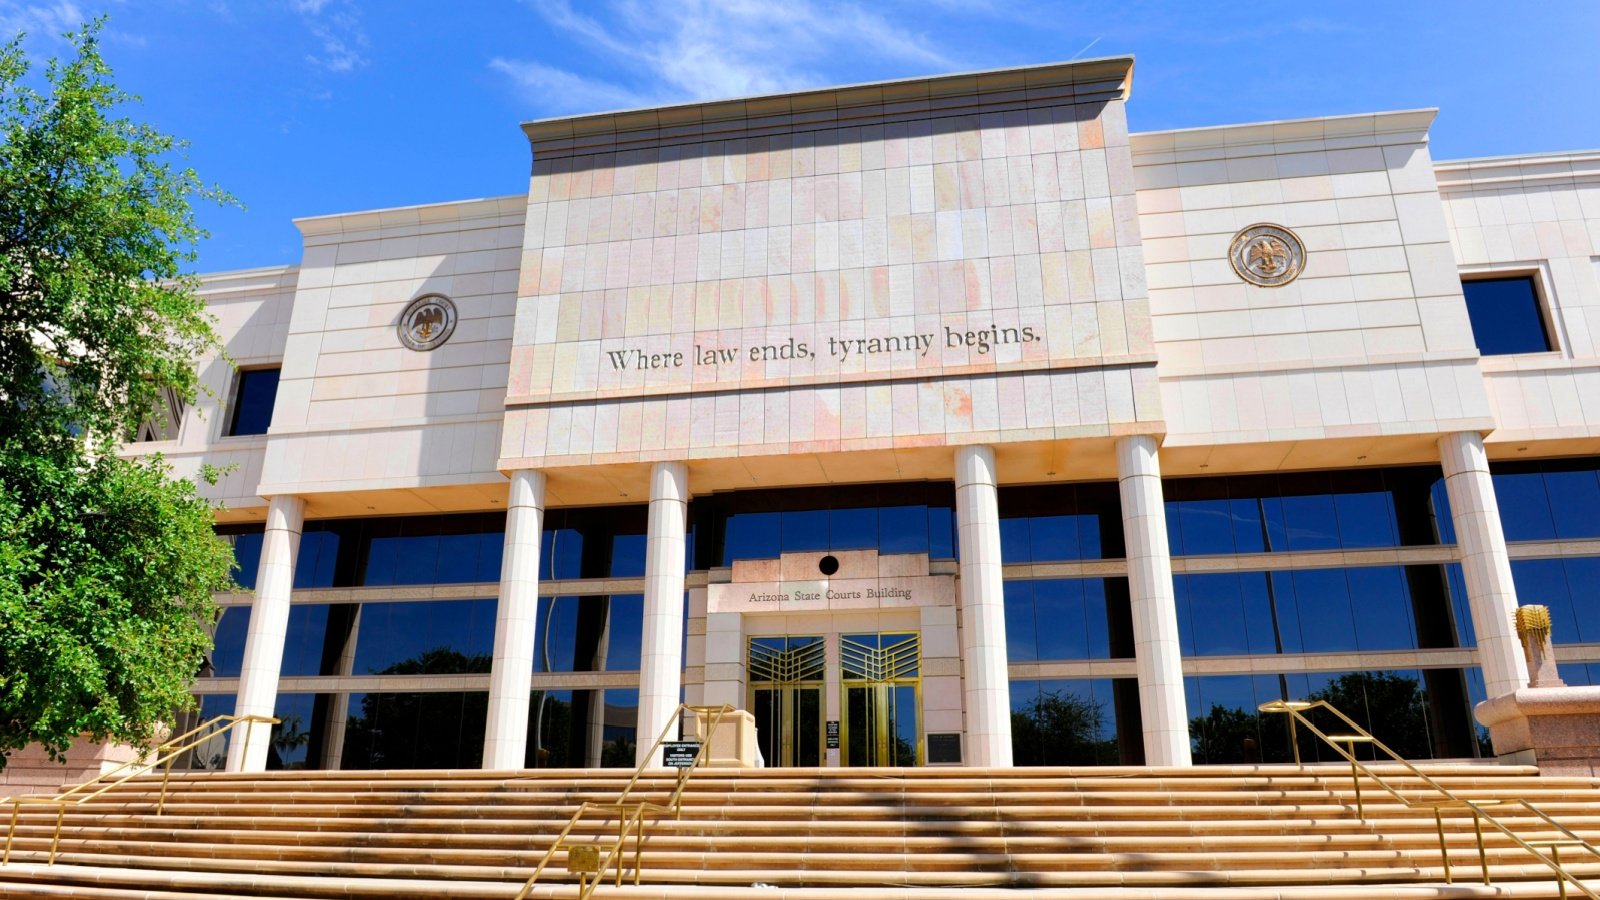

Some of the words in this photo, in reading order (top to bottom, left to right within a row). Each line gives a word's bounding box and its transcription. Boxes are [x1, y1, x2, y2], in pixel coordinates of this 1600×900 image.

[607, 350, 683, 371] Where
[695, 345, 738, 366] law
[750, 338, 815, 361] ends,
[828, 336, 934, 362] tyranny
[944, 324, 1041, 354] begins.
[749, 592, 789, 602] Arizona
[794, 591, 820, 601] State
[826, 589, 861, 600] Courts
[866, 588, 912, 600] Building
